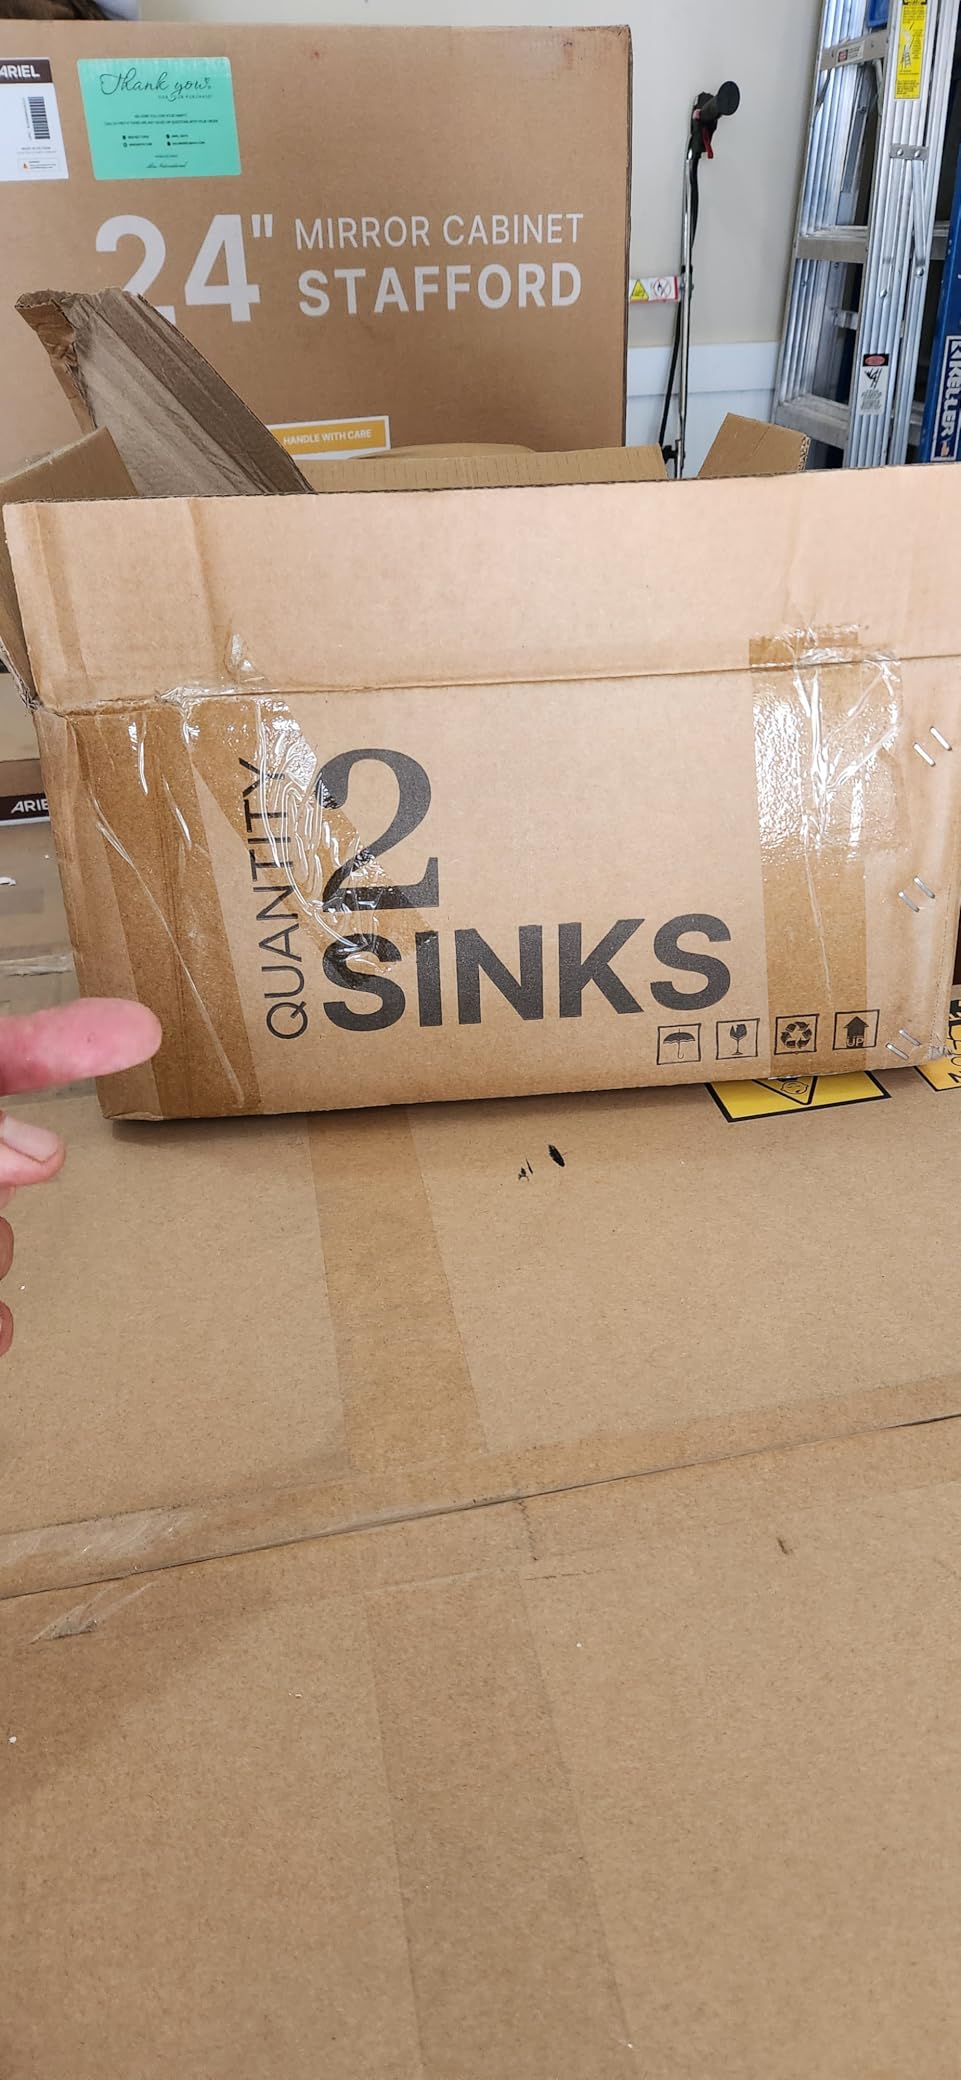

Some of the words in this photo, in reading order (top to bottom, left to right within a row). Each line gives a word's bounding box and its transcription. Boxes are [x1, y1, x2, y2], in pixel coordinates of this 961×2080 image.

[0, 64, 41, 80] ARIEL
[99, 67, 169, 96] Thank
[295, 216, 430, 251] MIRROR
[443, 212, 585, 247] CABINET
[298, 262, 583, 318] STAFFORD
[283, 434, 321, 446] HANDLE
[321, 431, 347, 443] WITH
[347, 429, 373, 441] CARE
[10, 798, 49, 815] ARIE
[314, 748, 440, 913] 2
[239, 757, 309, 1040] QUANTITY
[323, 913, 732, 1033] SINKS
[847, 1036, 865, 1047] UP
